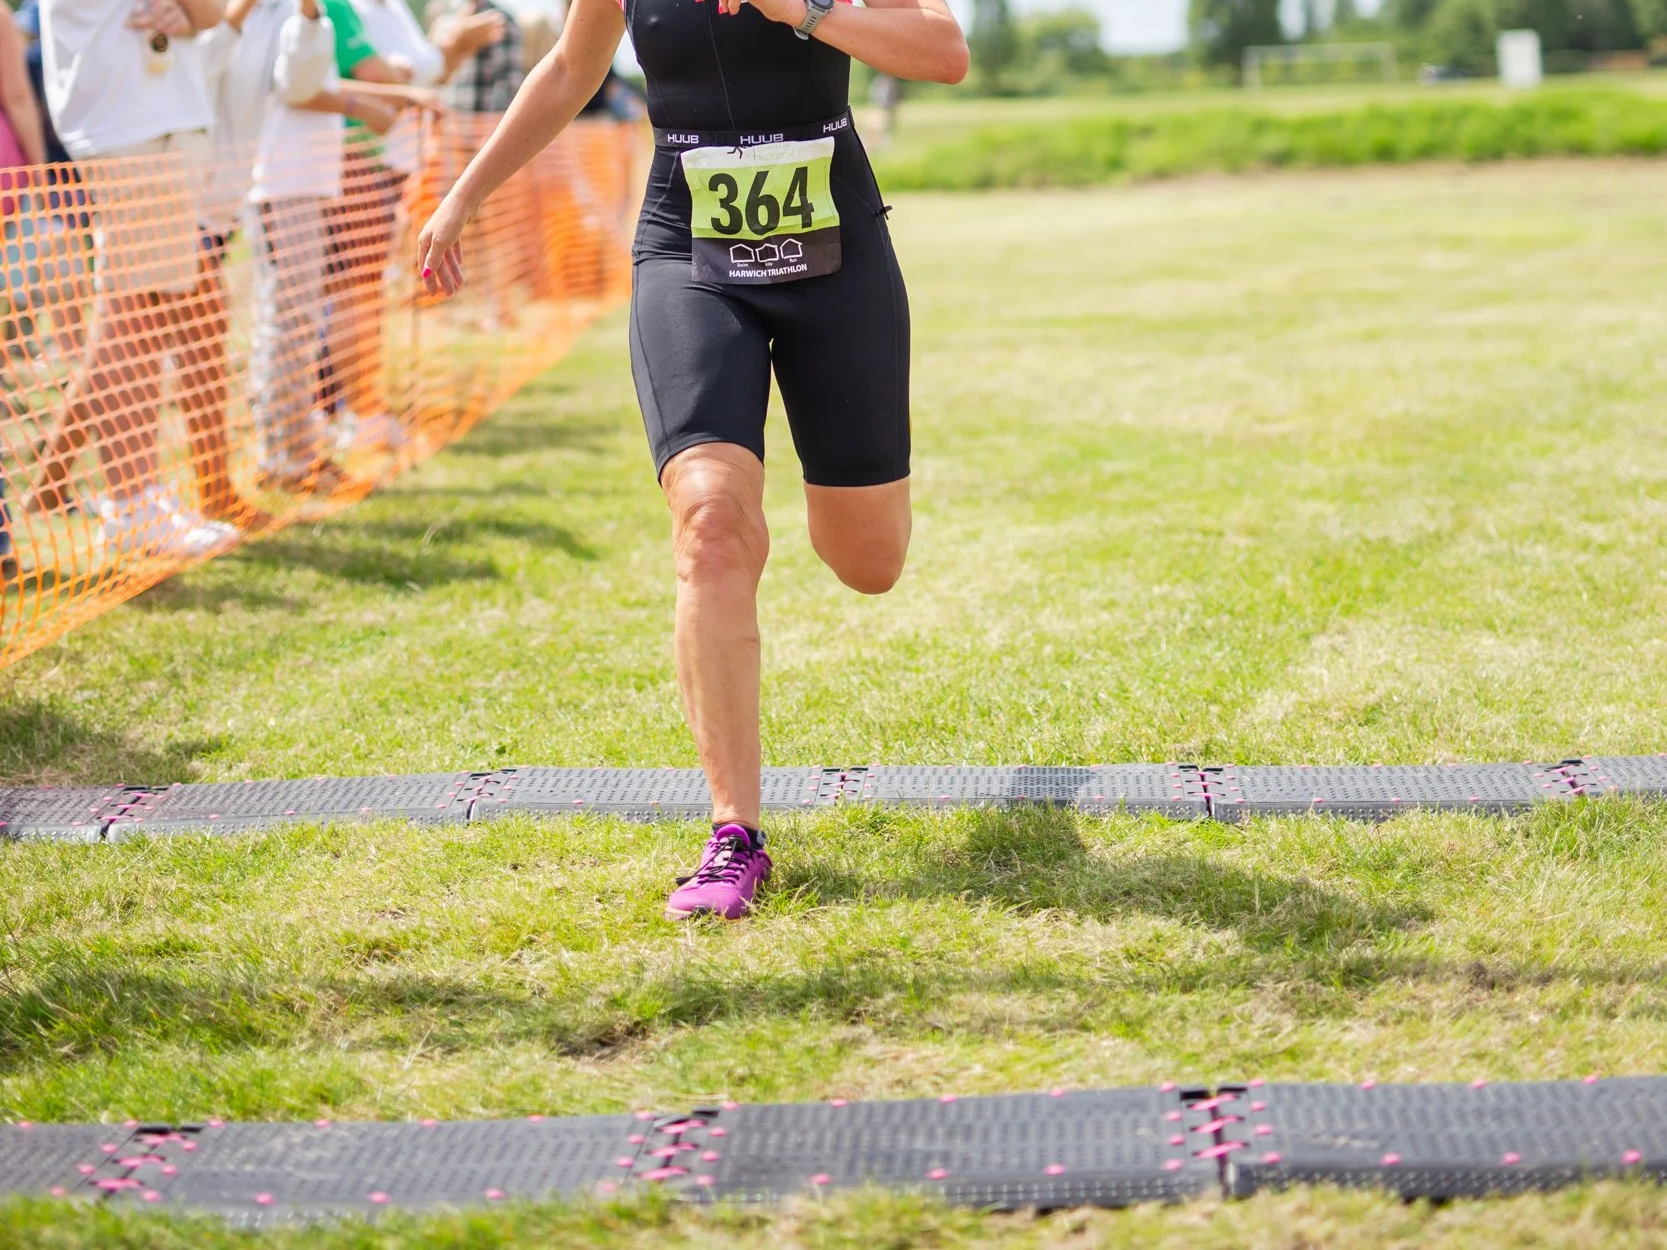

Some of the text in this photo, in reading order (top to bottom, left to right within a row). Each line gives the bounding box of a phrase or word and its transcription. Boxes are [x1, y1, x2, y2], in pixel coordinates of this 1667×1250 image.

[823, 118, 848, 133] HUUB
[667, 133, 699, 144] HUUB
[740, 133, 784, 145] HUUB
[708, 166, 815, 236] 364
[729, 263, 808, 278] HARWICH TRIATHLON
